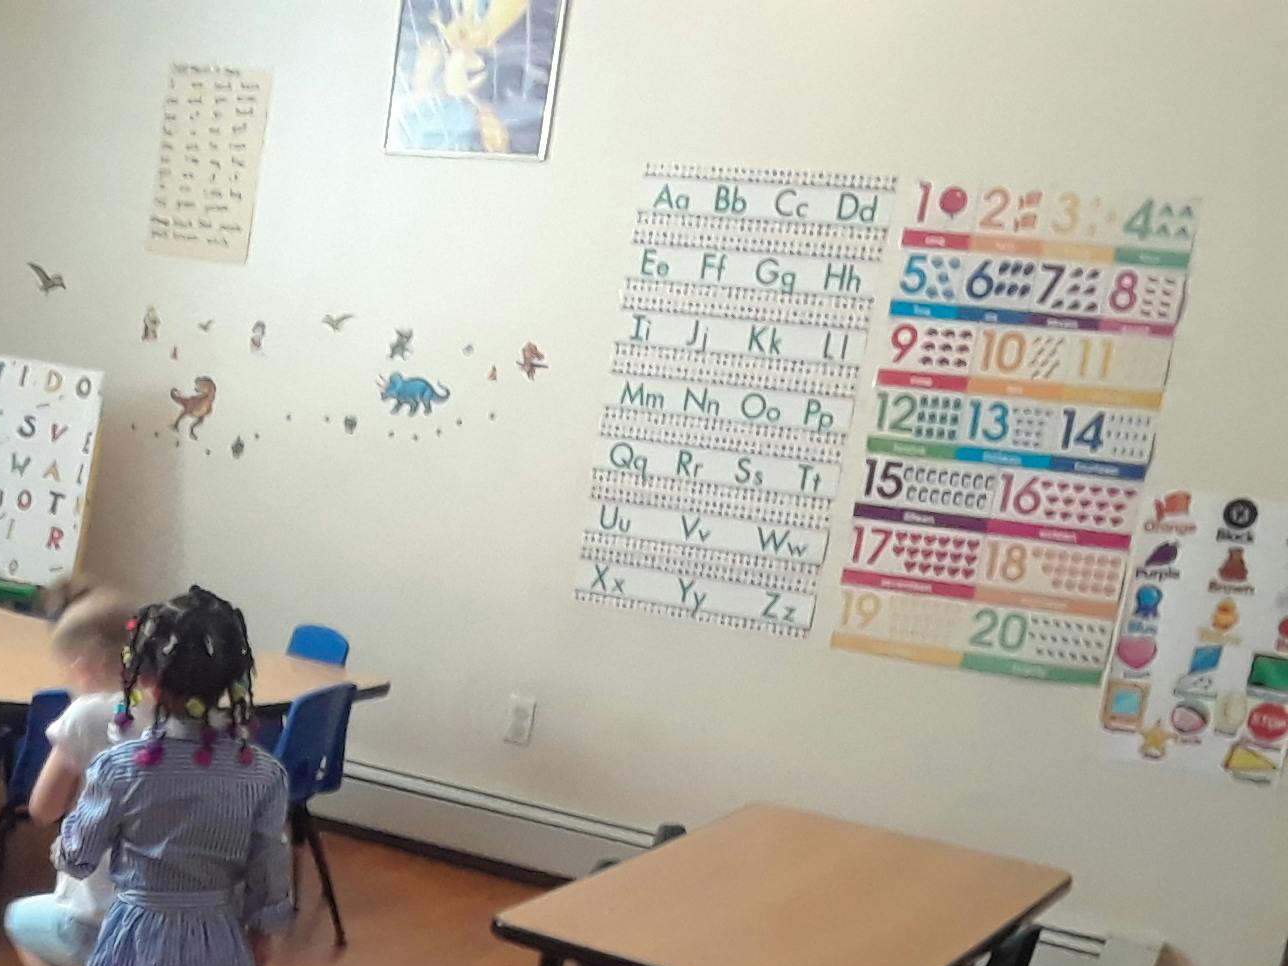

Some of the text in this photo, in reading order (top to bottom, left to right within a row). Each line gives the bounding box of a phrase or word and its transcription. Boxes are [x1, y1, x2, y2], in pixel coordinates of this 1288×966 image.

[653, 183, 878, 223] Aa Bb Cc Dd
[917, 181, 1155, 240] 1 2 3 4
[640, 249, 861, 295] Ee Ff Gg Hh
[900, 255, 1138, 312] 5 6 7 8
[630, 314, 651, 341] Ii
[686, 319, 709, 352] Jj
[748, 324, 782, 355] Kk
[891, 323, 1112, 378] 9 10 11
[44, 369, 63, 392] D
[75, 376, 92, 398] O
[620, 381, 834, 431] Mm Nn Oo Pp
[17, 415, 37, 438] S
[51, 423, 68, 442] V
[876, 391, 1106, 453] 12 13 14
[12, 452, 31, 477] W
[43, 460, 60, 482] A
[609, 442, 822, 492] Qq Rr Ss Tt
[864, 458, 1042, 516] 15 16
[17, 490, 32, 511] O
[48, 491, 66, 515] T
[46, 526, 64, 550] R
[599, 504, 807, 557] Uu Vv Ww
[852, 526, 1028, 582] 17 18
[1216, 529, 1254, 544] Black
[590, 564, 796, 622] Xx Yy Zz
[1135, 566, 1181, 581] Purple
[843, 591, 1029, 651] 19 20
